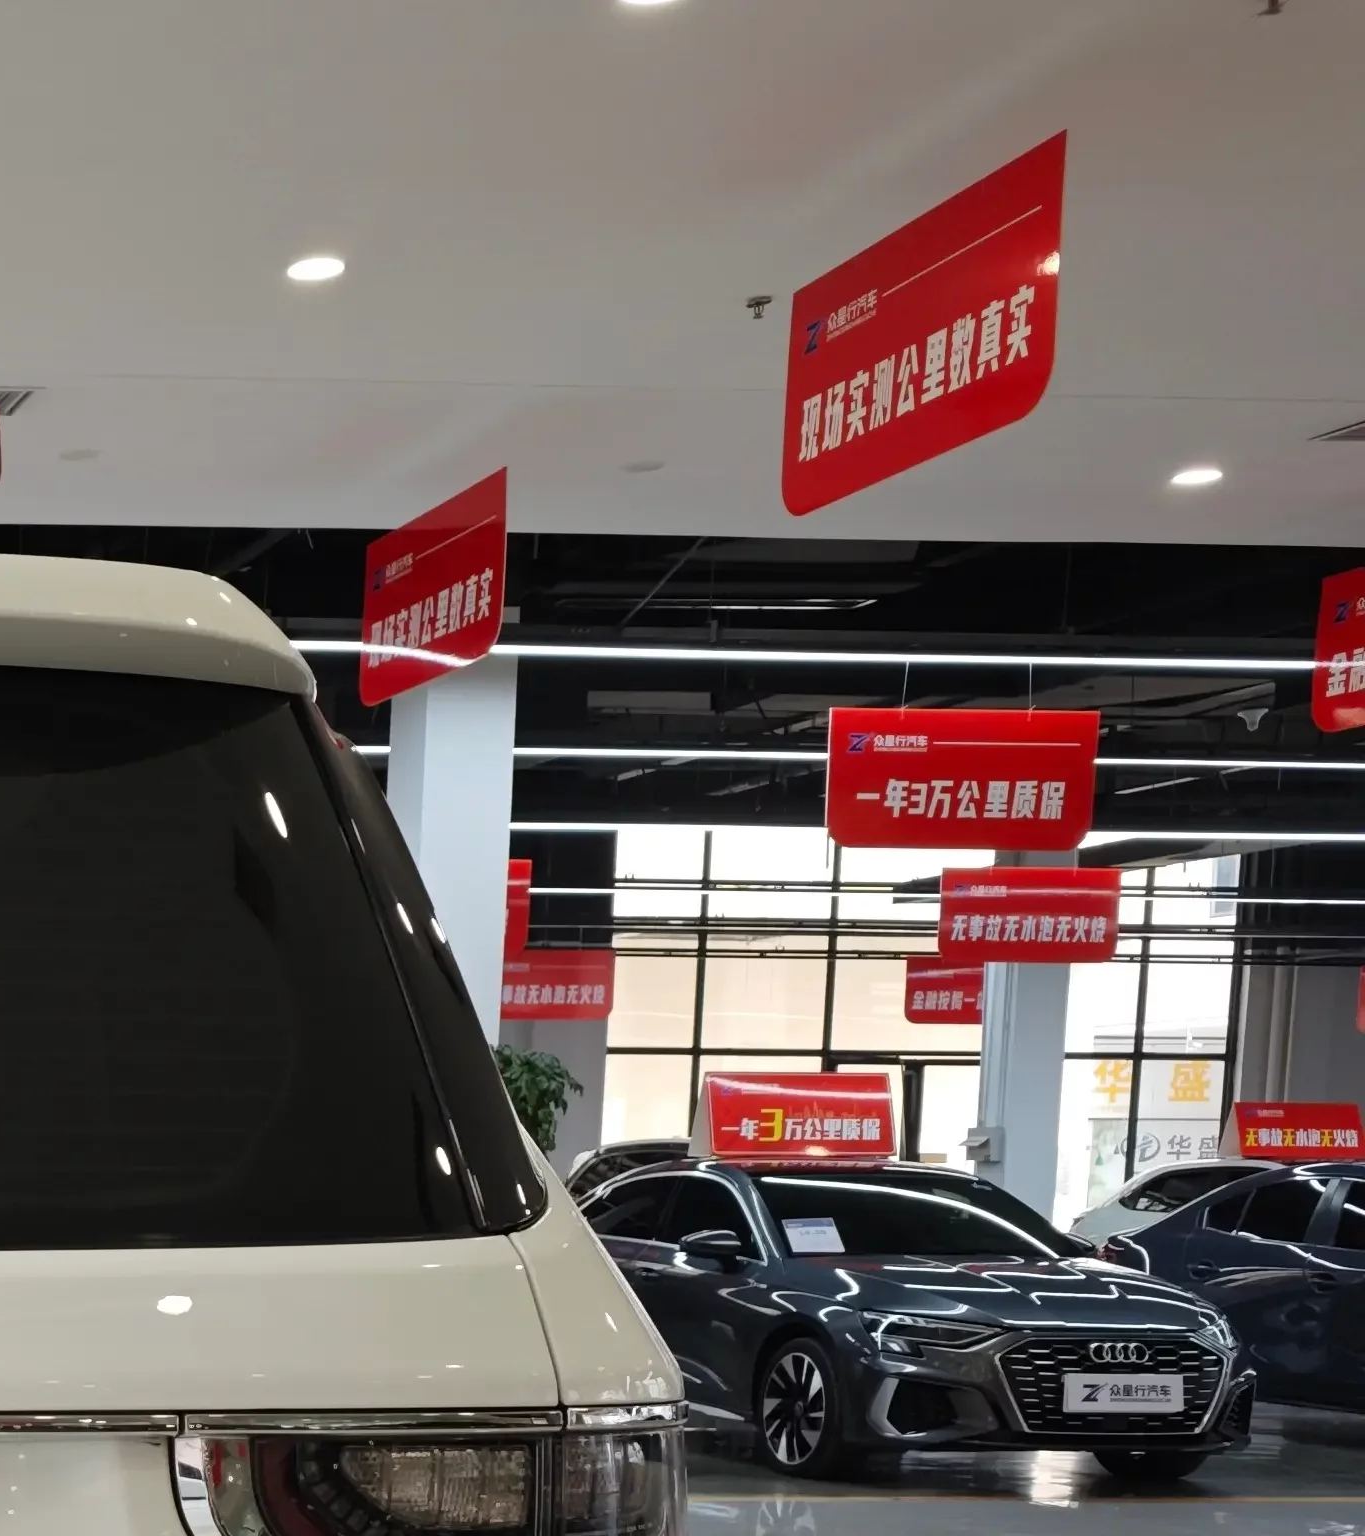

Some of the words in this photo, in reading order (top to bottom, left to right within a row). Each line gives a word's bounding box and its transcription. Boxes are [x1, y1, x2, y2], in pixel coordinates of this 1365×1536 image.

[798, 284, 1035, 462] 现场实测公里数真实
[856, 778, 1066, 820] 一年3万公里质保
[950, 914, 1108, 943] 无事故无水泡无火烧
[721, 1108, 881, 1142] 一年3万公里质保
[1166, 1134, 1218, 1160] 华盛
[1109, 1384, 1172, 1397] 众星行汽车
